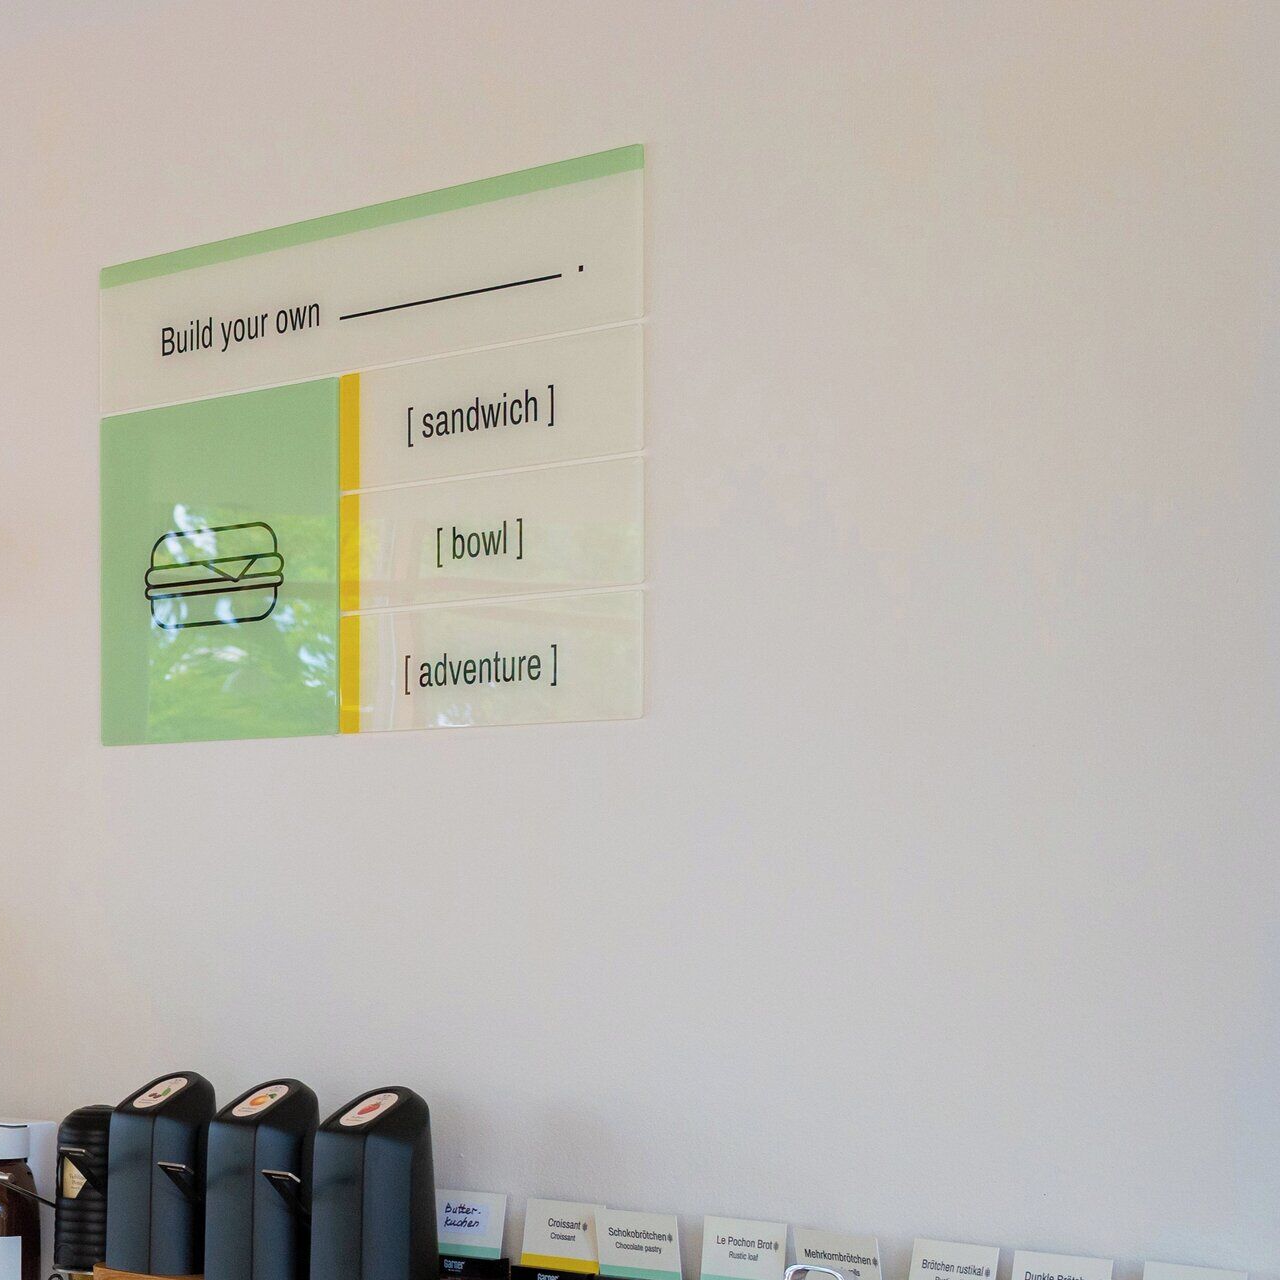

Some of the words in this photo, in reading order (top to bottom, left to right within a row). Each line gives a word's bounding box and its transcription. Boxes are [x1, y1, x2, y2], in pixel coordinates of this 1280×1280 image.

[160, 316, 214, 357] Build
[221, 312, 269, 353] your
[275, 301, 321, 334] own
[547, 1217, 581, 1231] Croissant
[550, 1231, 576, 1243] Croissant
[608, 1226, 667, 1243] Schokobrötchen
[615, 1241, 644, 1252] Chocolate
[644, 1245, 662, 1255] pastry
[716, 1234, 726, 1246] Le
[727, 1235, 756, 1249] Pochon
[757, 1238, 773, 1251] Brot
[728, 1250, 747, 1261] Rustic
[747, 1252, 759, 1262] loaf
[804, 1248, 872, 1266] Mehrkornbrötchen
[443, 1258, 465, 1270] Garner
[921, 1258, 955, 1273] Brötchen
[956, 1264, 984, 1277] rustikal
